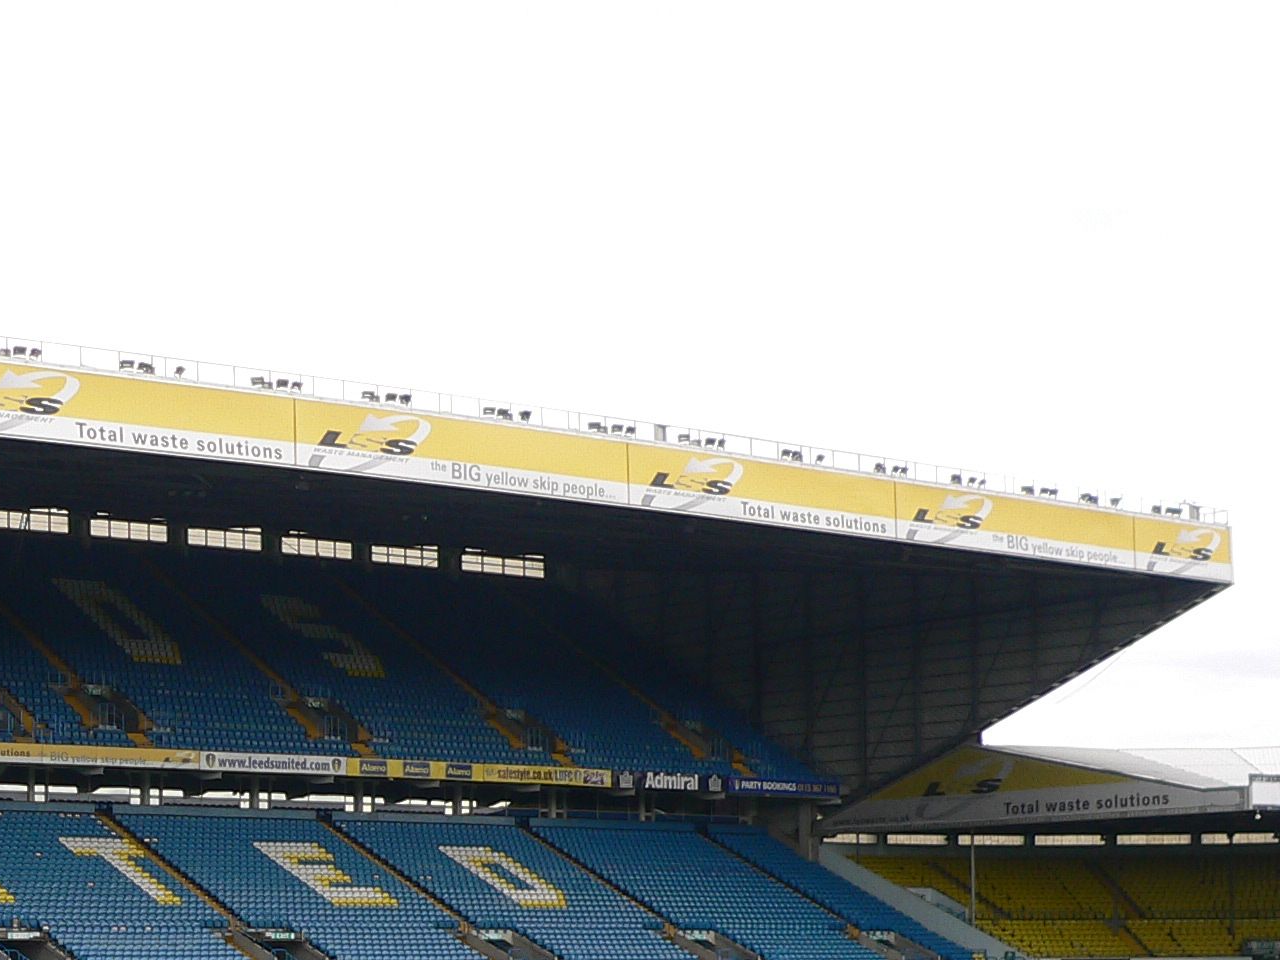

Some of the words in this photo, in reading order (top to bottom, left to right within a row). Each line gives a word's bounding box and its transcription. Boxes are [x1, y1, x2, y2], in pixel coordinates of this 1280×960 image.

[75, 421, 124, 443] Total
[132, 431, 189, 450] waste
[196, 437, 283, 460] solutions
[430, 460, 447, 473] the
[451, 462, 481, 482] BIG
[486, 471, 529, 488] yellow
[532, 475, 559, 495] skip
[740, 501, 775, 519] Total
[780, 509, 820, 525] waste
[825, 514, 887, 534] solutions
[1007, 534, 1029, 551] BIG
[1031, 541, 1063, 557] yellow
[1065, 544, 1086, 560] skip
[217, 755, 331, 772] www.leedsunited.com
[361, 763, 386, 774] Alamo
[447, 767, 471, 778] Alamo
[645, 771, 699, 791] Admiral
[1004, 799, 1039, 815] Total
[1046, 798, 1090, 812] waste
[1096, 793, 1169, 810] solutions
